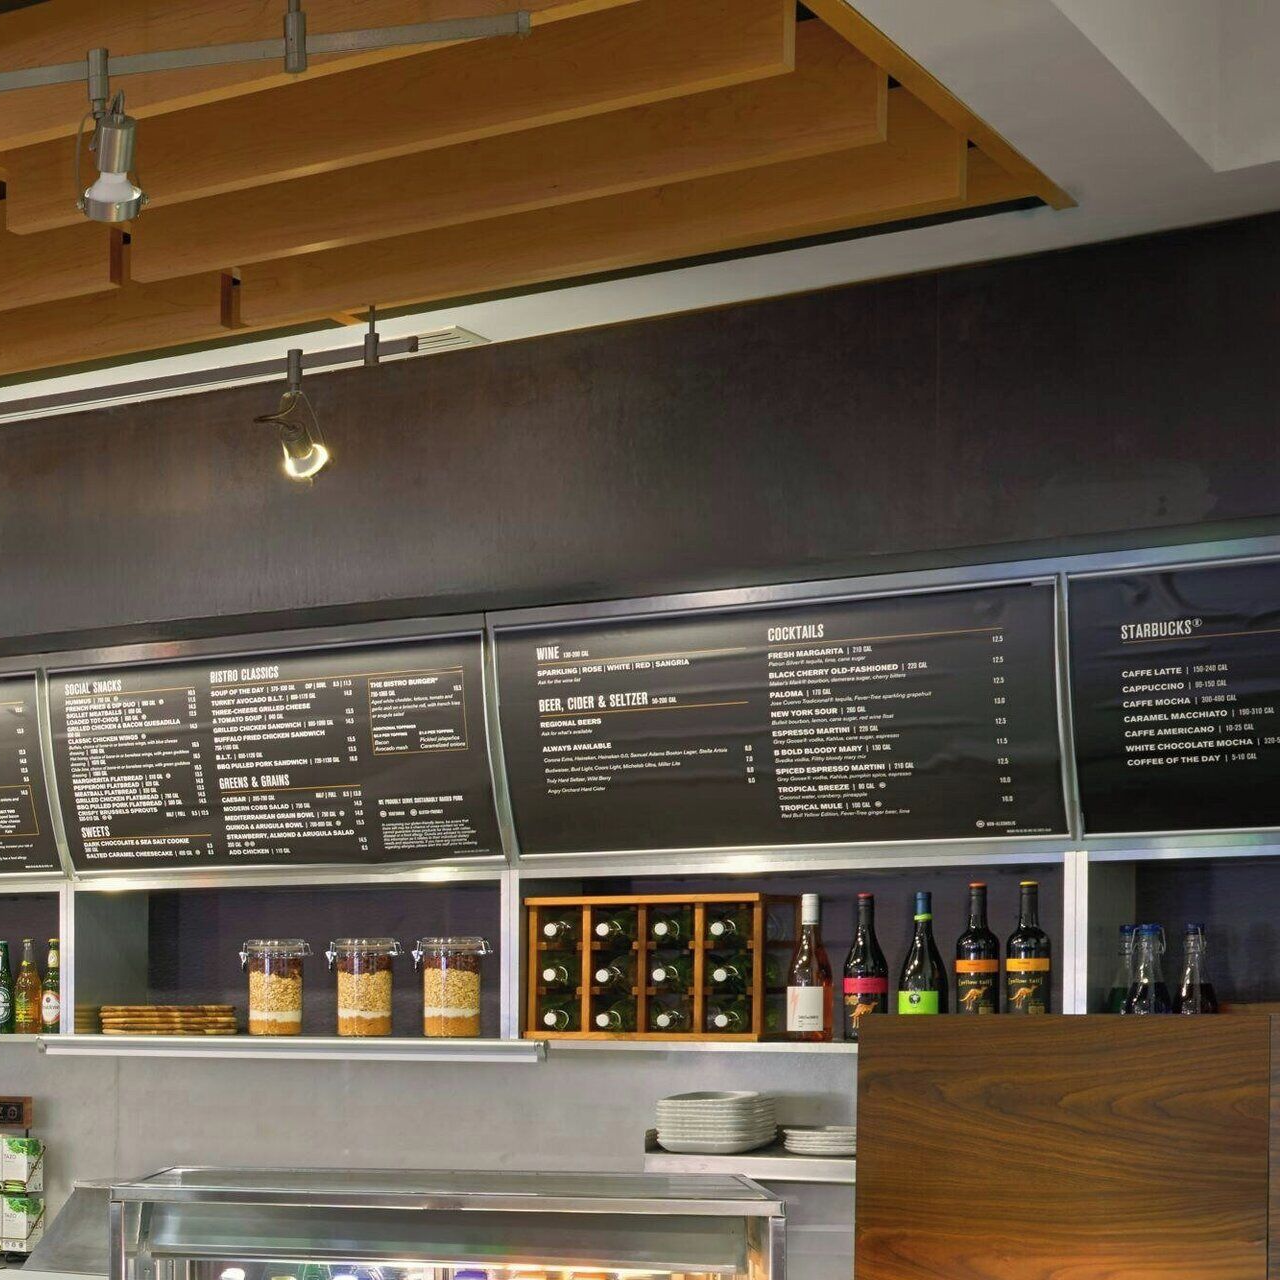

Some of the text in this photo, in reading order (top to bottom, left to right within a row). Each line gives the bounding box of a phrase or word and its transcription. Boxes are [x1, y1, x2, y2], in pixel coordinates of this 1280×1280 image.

[768, 624, 824, 642] COCKTAILS
[537, 646, 559, 661] WINE
[768, 652, 795, 660] FRESH
[796, 648, 843, 657] MARGARITA
[537, 668, 578, 676] SPARKLING
[582, 665, 603, 673] ROSE
[607, 663, 630, 671] WHITE
[655, 659, 689, 668] SANGRIA
[769, 664, 898, 679] BLACK CHERRY OLD-FASHIONED
[1122, 669, 1152, 678] CAFFE
[1154, 667, 1182, 676] LATTE
[210, 666, 279, 683] BISTRO CLASSICS
[65, 680, 121, 695] SOCIAL SNACKS
[1122, 683, 1184, 693] CAPPUCCINO
[770, 690, 803, 699] PALOMA
[539, 692, 648, 712] BEER, CIDER & SELTZER
[1123, 697, 1190, 708] CAFFE MOCHA
[211, 708, 258, 716] THREE-CHEESE
[791, 709, 813, 717] YORK
[1124, 714, 1168, 723] CARAMEL
[1171, 710, 1227, 720] MACCHIATO
[540, 720, 576, 728] REGIONAL
[772, 727, 850, 737] ESPRESSO MARTINI
[1125, 730, 1155, 738] CAFFE
[1157, 726, 1214, 735] AMERICANO
[839, 745, 863, 753] MARY
[1126, 739, 1253, 752] WHITE CHOCOLATE MOCHA
[1127, 757, 1164, 766] COFFEE
[775, 763, 885, 776] SPICED ESPRESSO MARTINI
[219, 774, 290, 789] GREENS & GRAINS
[778, 785, 817, 793] TROPICAL
[81, 826, 110, 838] SWEETS
